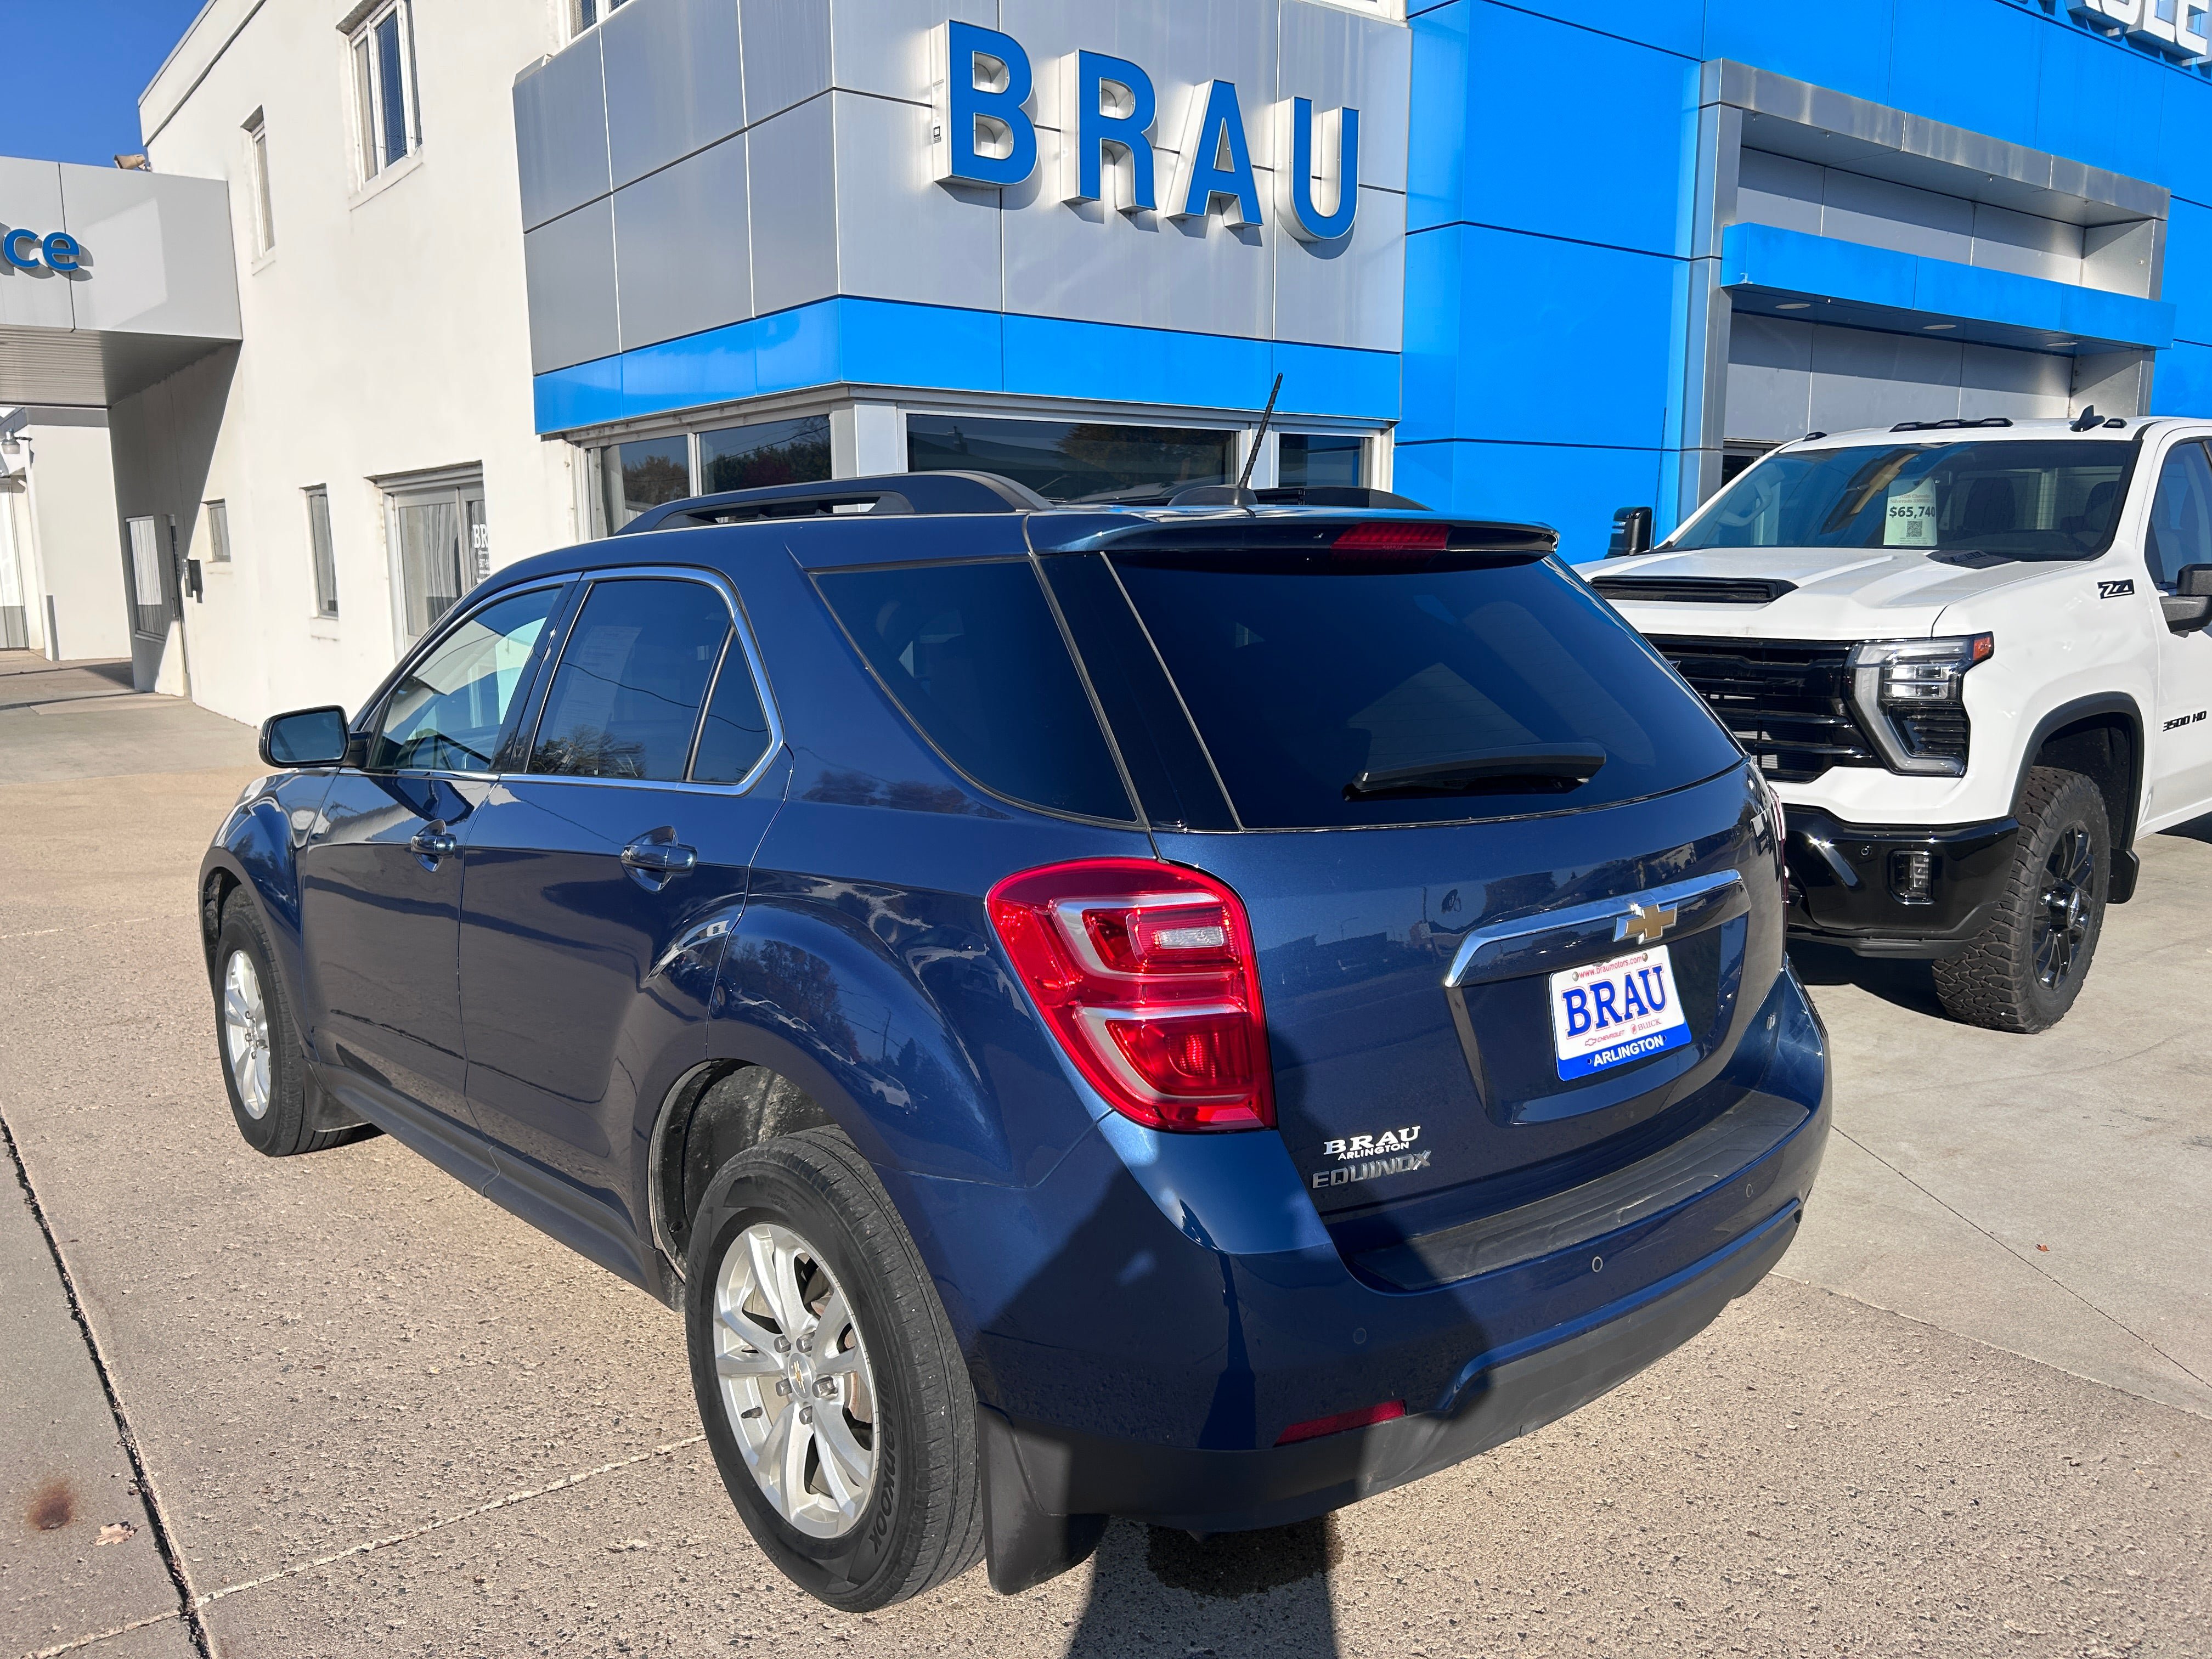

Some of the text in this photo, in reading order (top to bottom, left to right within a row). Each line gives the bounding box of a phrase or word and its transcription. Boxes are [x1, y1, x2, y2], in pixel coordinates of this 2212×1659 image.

[938, 19, 1359, 240] BRAU
[1889, 506, 1936, 519] $65,740
[2163, 710, 2207, 732] 3500 HD
[1578, 956, 1642, 978] www.braumotors.com
[1561, 964, 1667, 1038] BRAU
[1597, 1018, 1662, 1043] CHEVROLET BUICK
[1593, 1034, 1664, 1067] ARLINGTON
[1323, 1126, 1421, 1155] BRAU
[1338, 1141, 1409, 1161] ARLINGTON
[1312, 1150, 1431, 1189] EQUINOX
